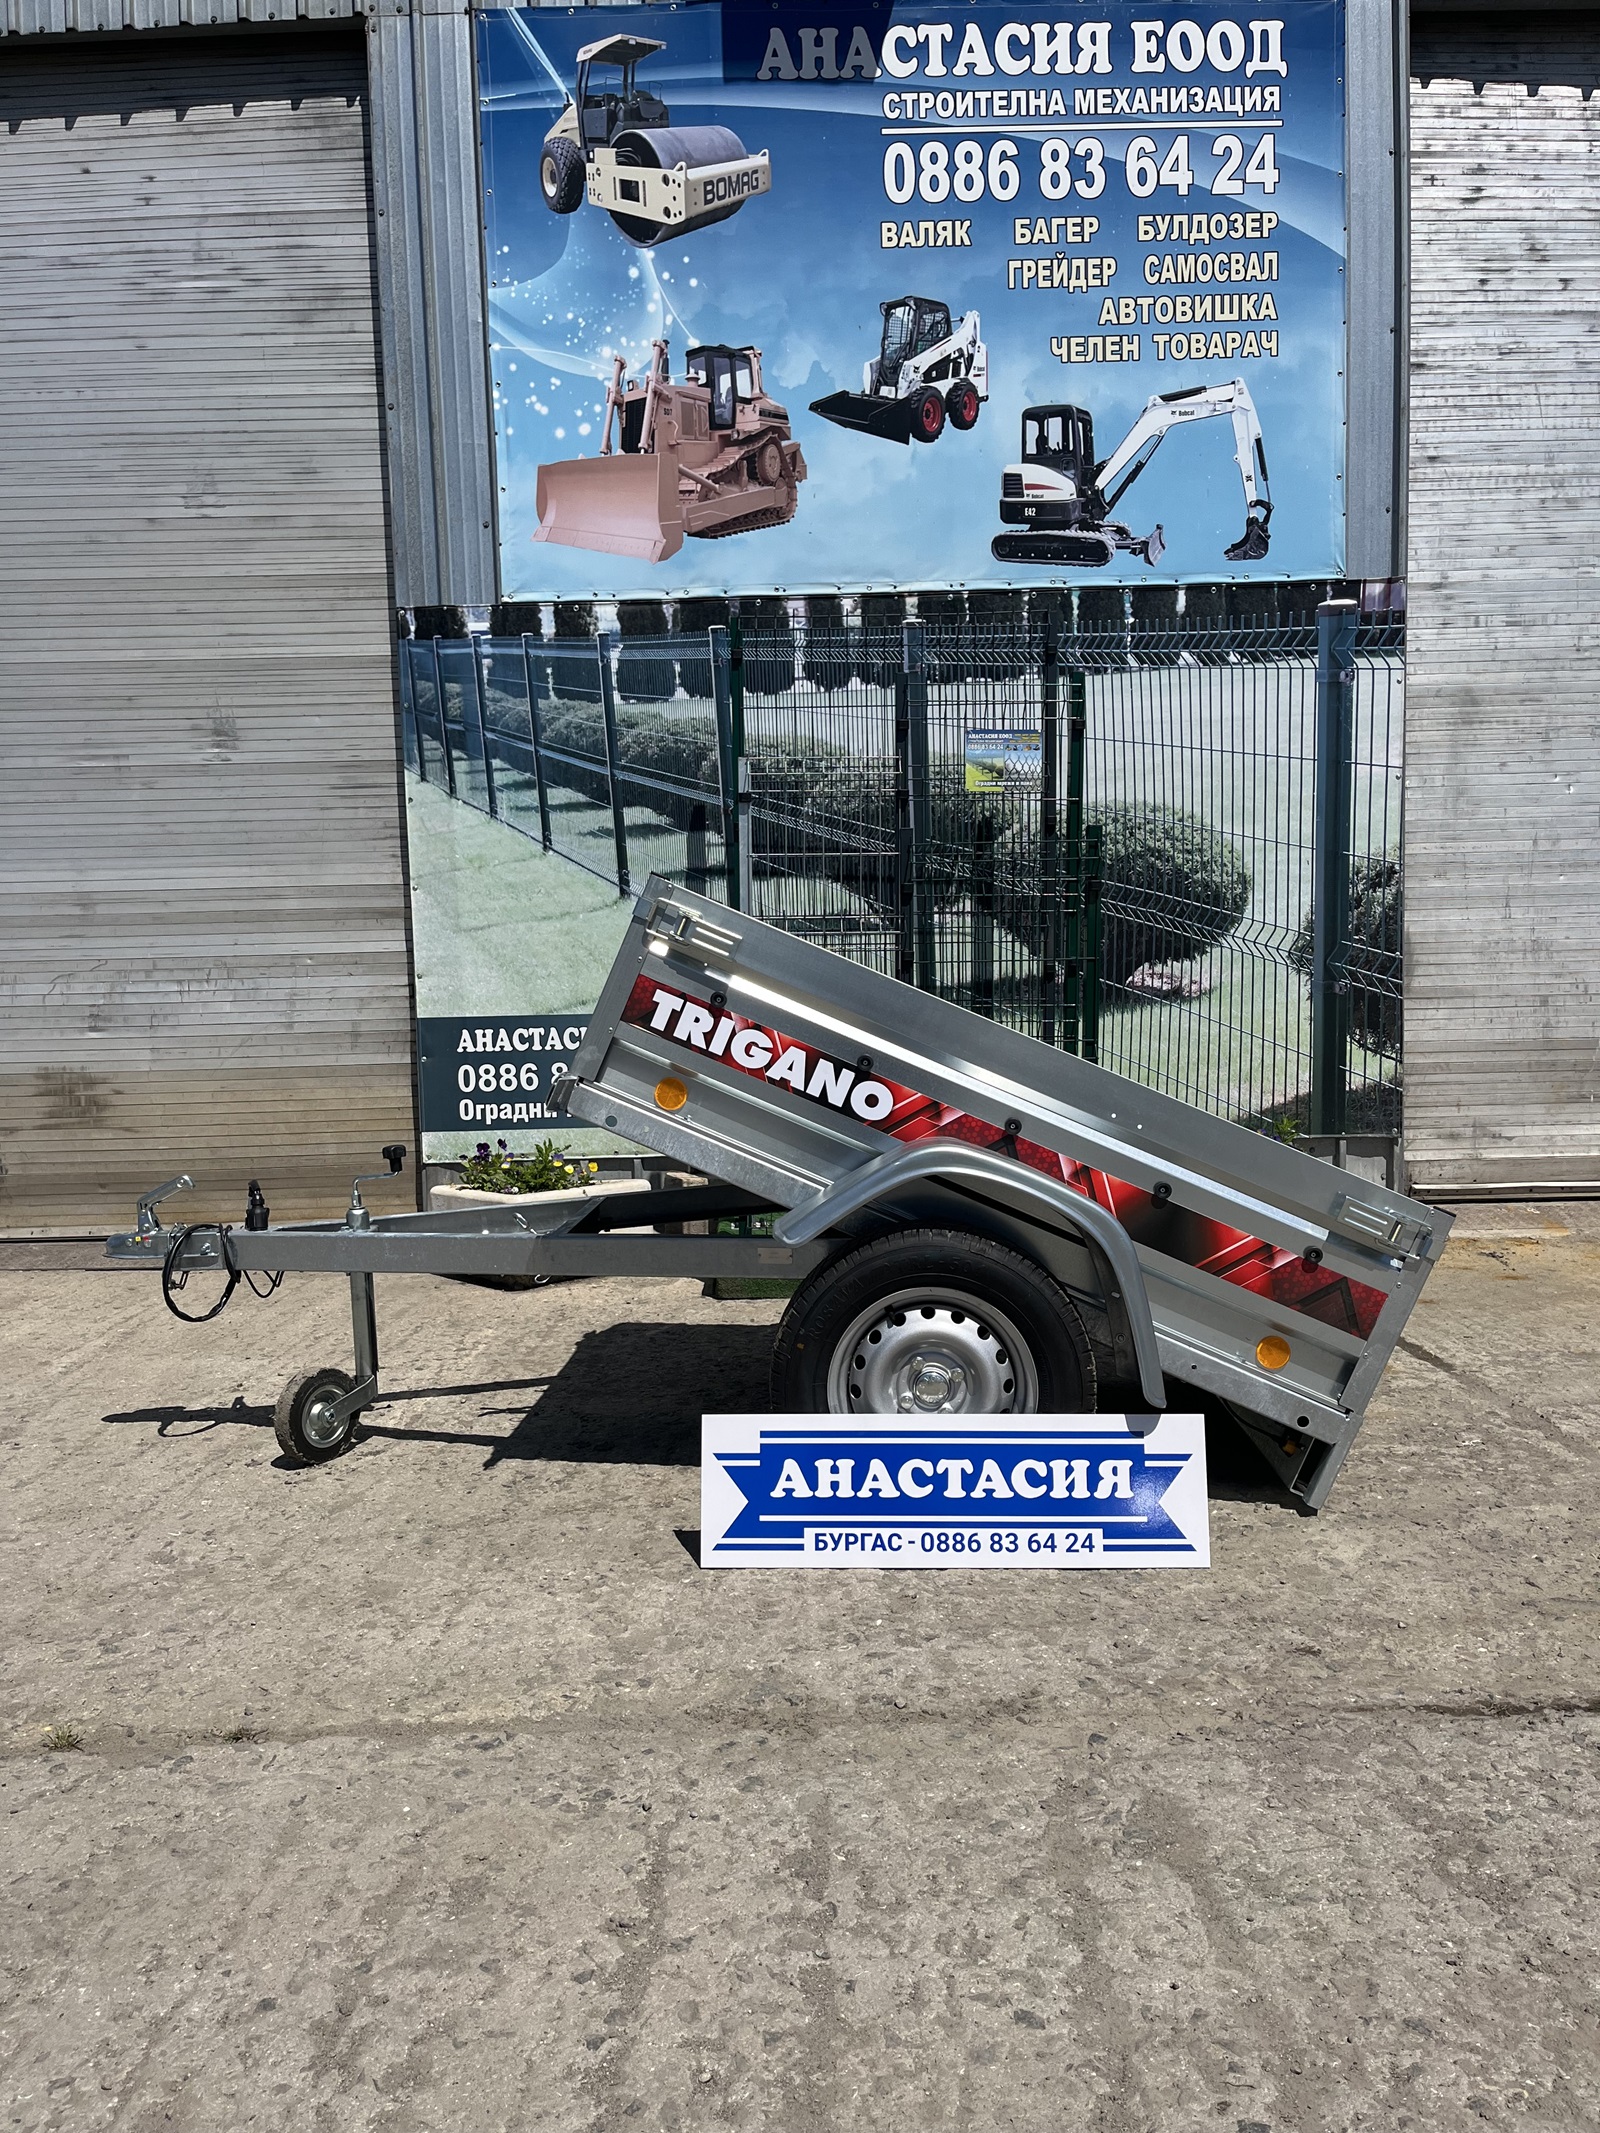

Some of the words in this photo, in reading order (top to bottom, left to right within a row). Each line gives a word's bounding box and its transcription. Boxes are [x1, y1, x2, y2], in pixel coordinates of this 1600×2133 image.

[756, 22, 1112, 80] АНАСТАСИЯ
[1130, 20, 1287, 78] ЕООД
[882, 89, 1066, 119] СТРОИТЕЛНА
[1074, 85, 1281, 116] МЕХАНИЗАЦИЯ
[883, 139, 1020, 204] 0886
[1039, 137, 1106, 200] 83
[1125, 134, 1193, 197] 64
[1211, 132, 1280, 195] 24
[703, 169, 759, 206] BOMAG
[881, 220, 972, 248] ВАЛЯК
[1014, 216, 1099, 245] БАГЕР
[1137, 211, 1279, 244] БУЛДОЗЕР
[1008, 252, 1117, 293] ГРЕЙДЕР
[1143, 251, 1279, 285] САМОСВАЛ
[1098, 293, 1278, 325] АВТОВИШКА
[1050, 334, 1140, 363] ЧЕЛЕН
[1152, 330, 1279, 361] ТОВАРАЧ
[1178, 409, 1195, 417] Bobcat
[1024, 507, 1036, 517] E42
[650, 988, 893, 1121] TRIGANO
[458, 1062, 539, 1092] 0886
[770, 1458, 1134, 1499] АНАСТАСИЯ
[813, 1532, 902, 1553] БУРГАС
[920, 1531, 981, 1553] 0886
[989, 1531, 1018, 1553] 83
[1027, 1531, 1057, 1553] 64
[1064, 1531, 1095, 1553] 24
